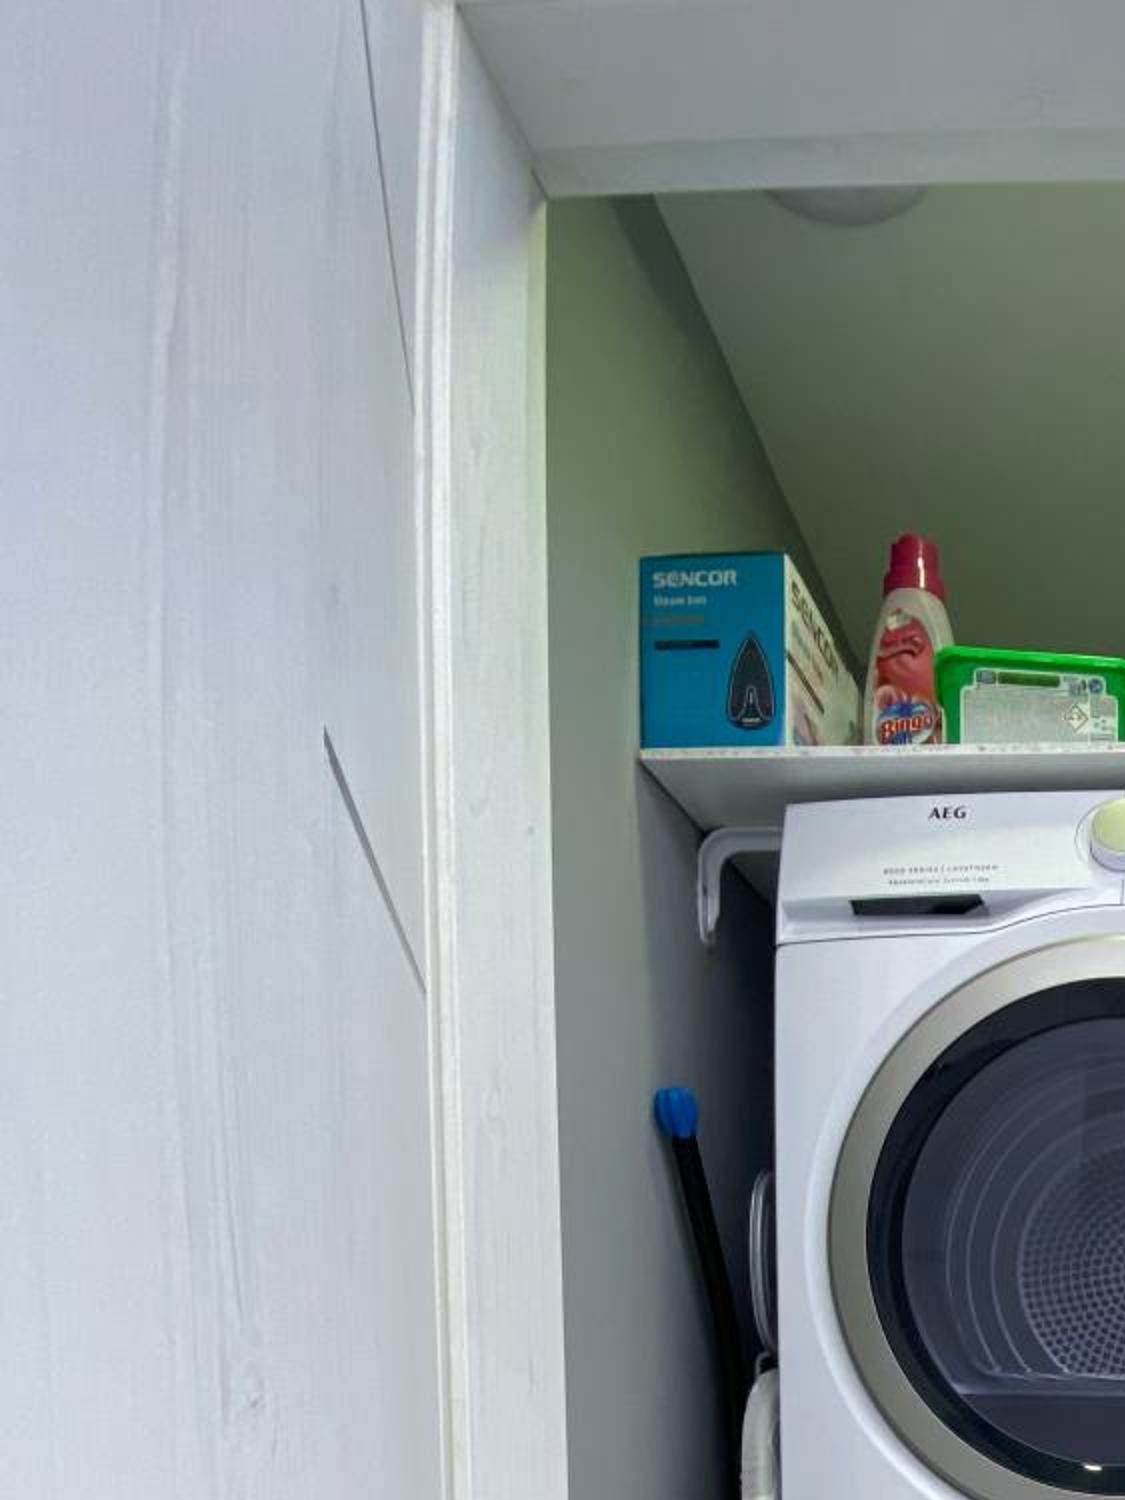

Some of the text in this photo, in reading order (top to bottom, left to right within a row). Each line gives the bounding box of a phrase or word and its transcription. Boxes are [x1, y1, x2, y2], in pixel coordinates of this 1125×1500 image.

[652, 569, 738, 588] SENCOR
[880, 714, 933, 738] Bingo
[927, 804, 968, 821] AEG
